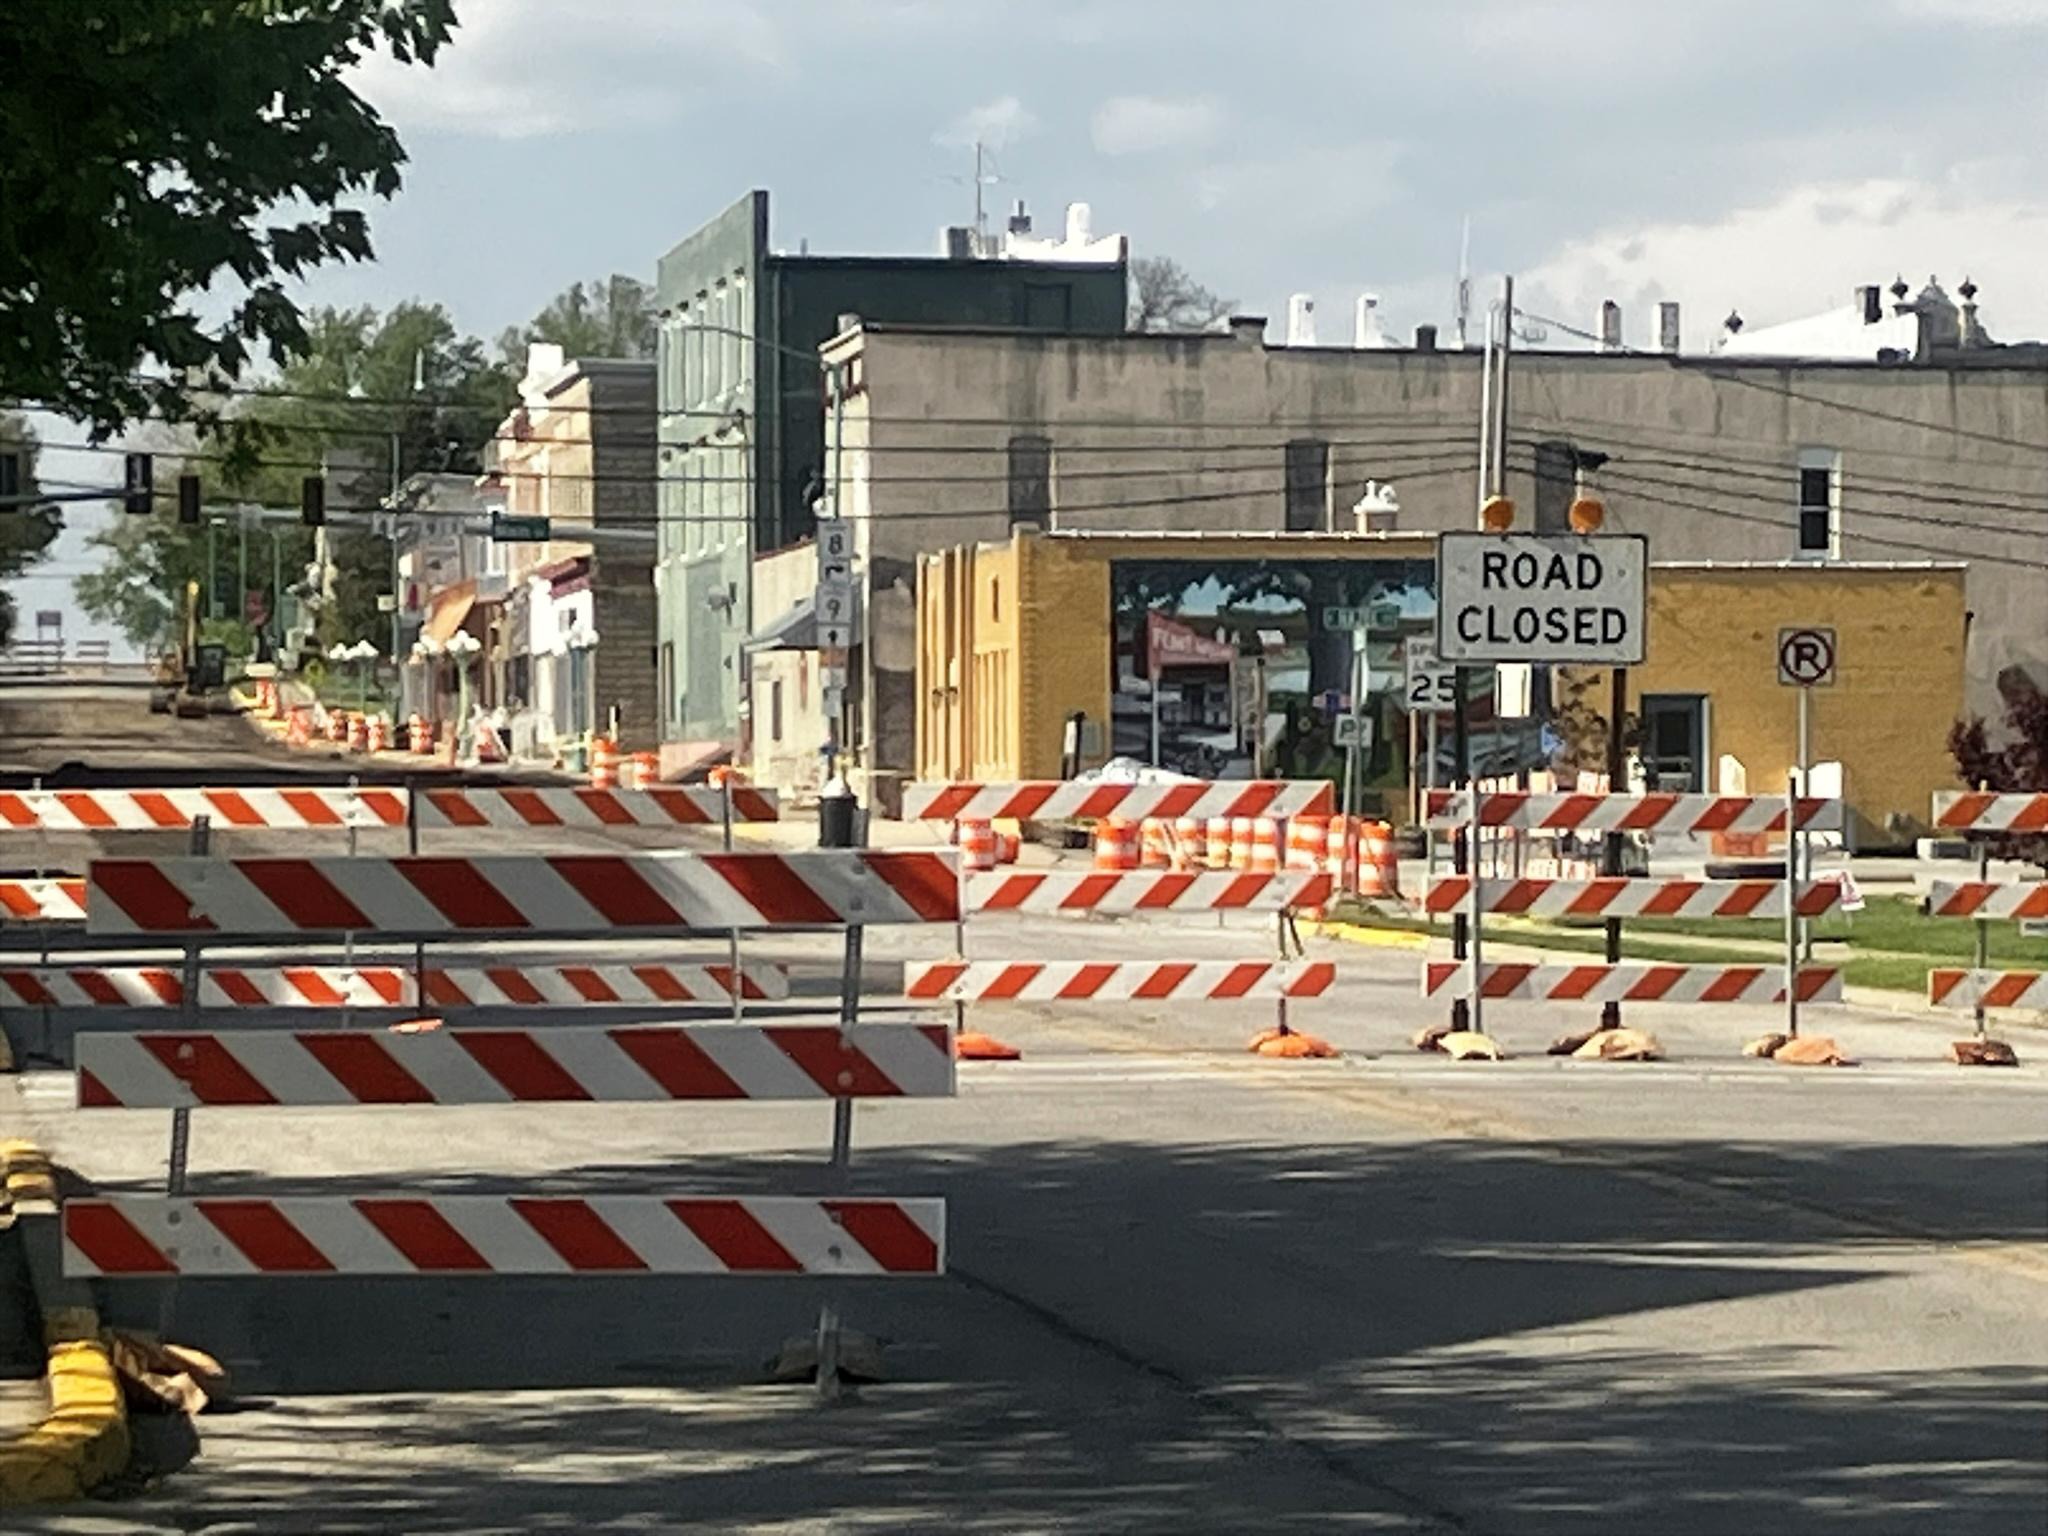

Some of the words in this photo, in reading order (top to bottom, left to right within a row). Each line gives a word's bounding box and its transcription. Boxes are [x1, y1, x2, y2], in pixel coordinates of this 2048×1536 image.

[828, 533, 843, 555] 8
[1483, 552, 1603, 590] ROAD
[1457, 605, 1627, 646] CLOSED
[1410, 674, 1456, 702] 25
